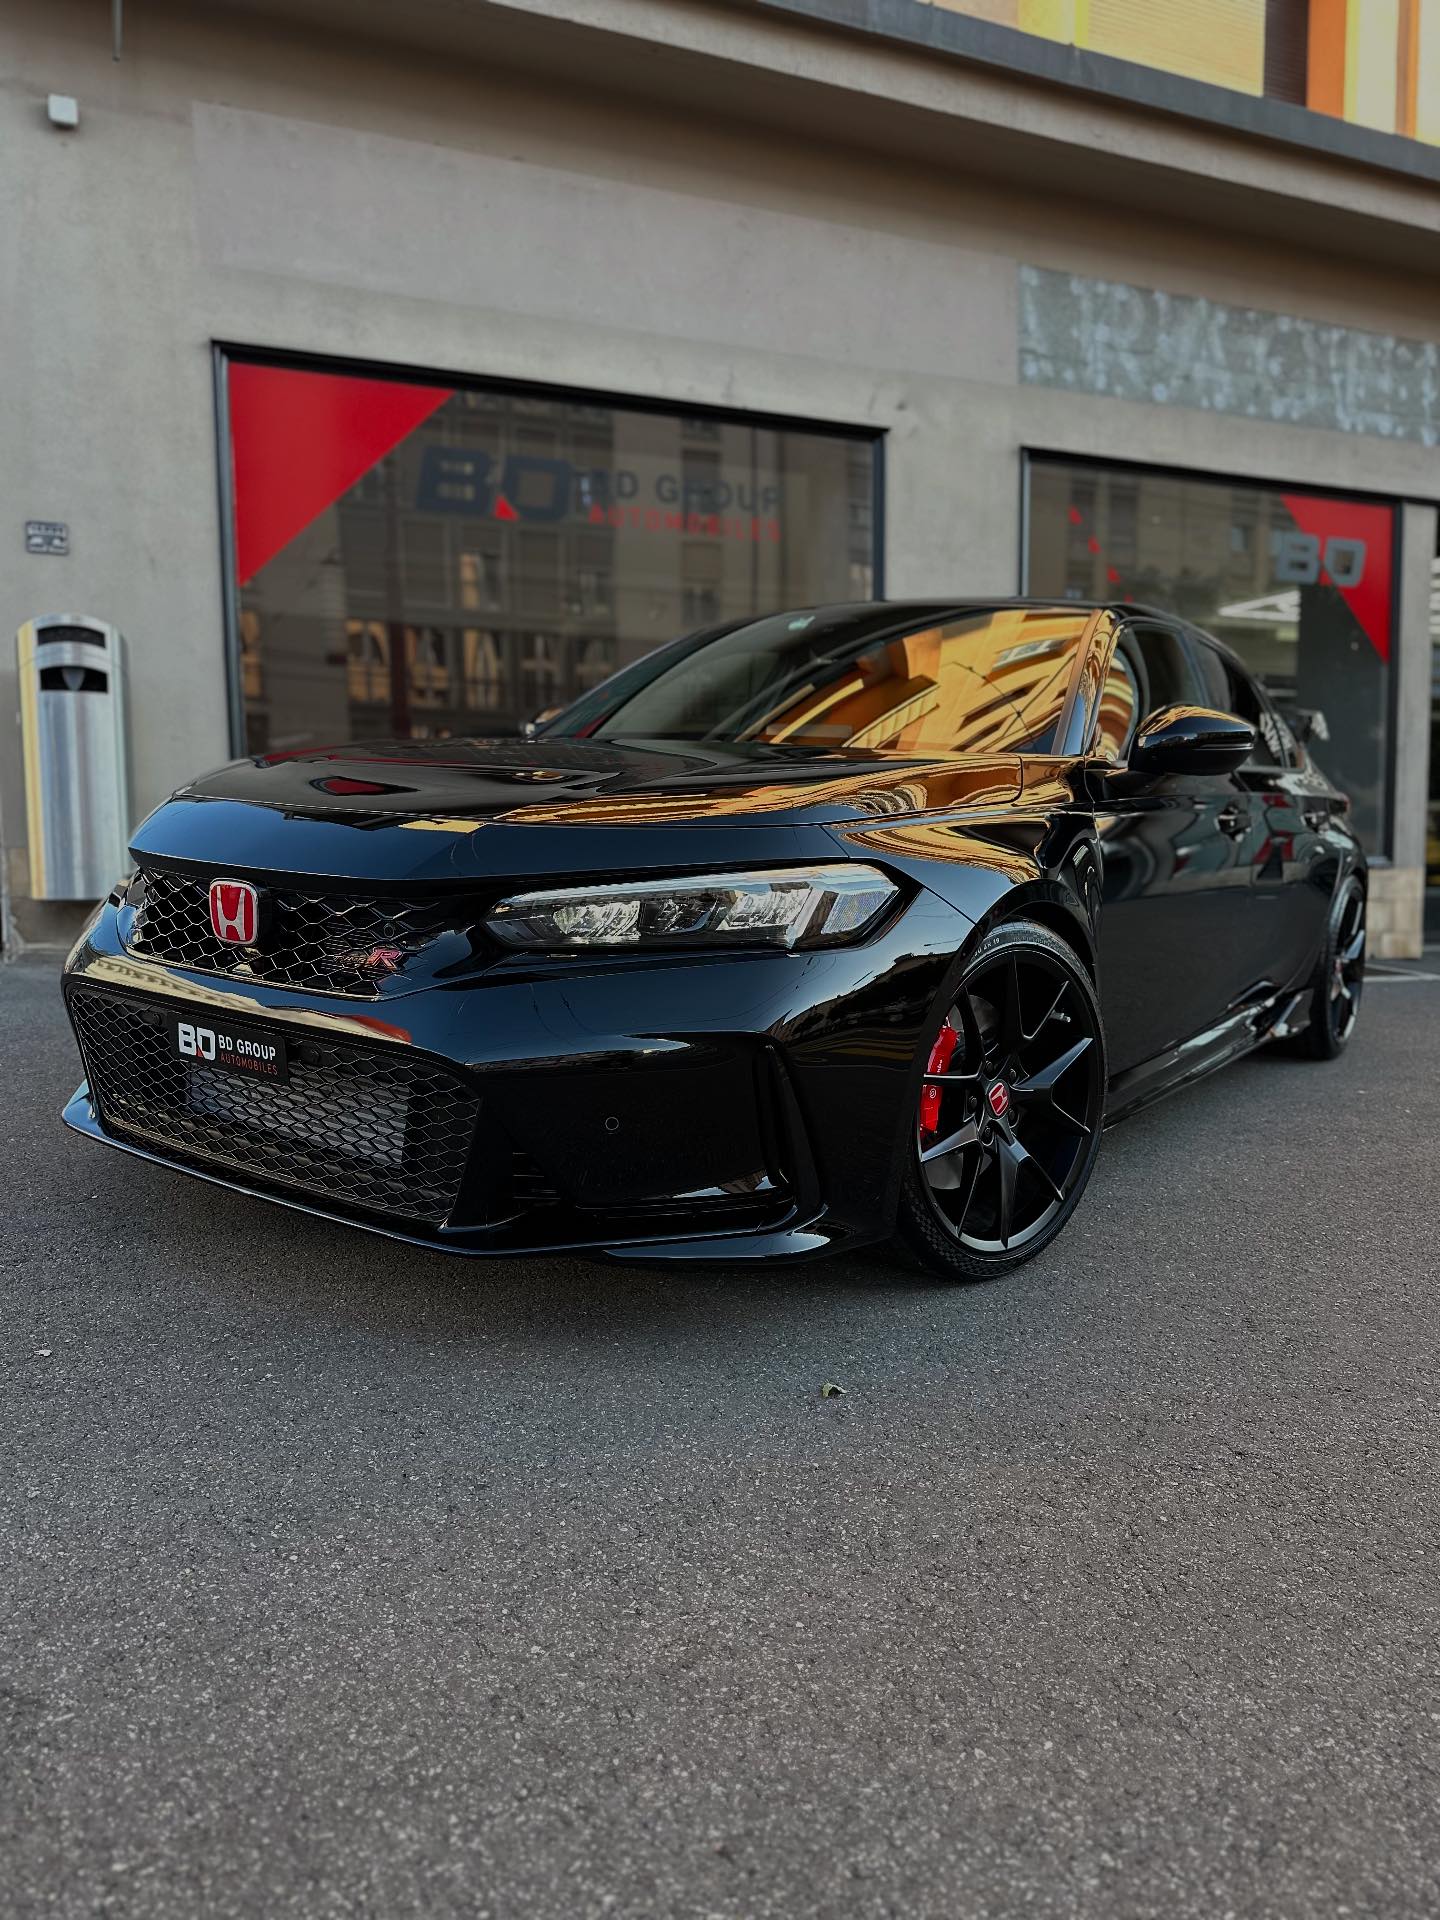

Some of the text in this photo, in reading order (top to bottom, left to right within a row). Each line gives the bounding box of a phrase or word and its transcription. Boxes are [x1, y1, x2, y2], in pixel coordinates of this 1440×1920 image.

[655, 474, 780, 513] GROUP
[588, 504, 781, 543] AUTOMOBILES
[178, 1022, 216, 1061] BD
[218, 1034, 276, 1061] BD GROUP
[220, 1051, 278, 1076] AUTOMOBILES
